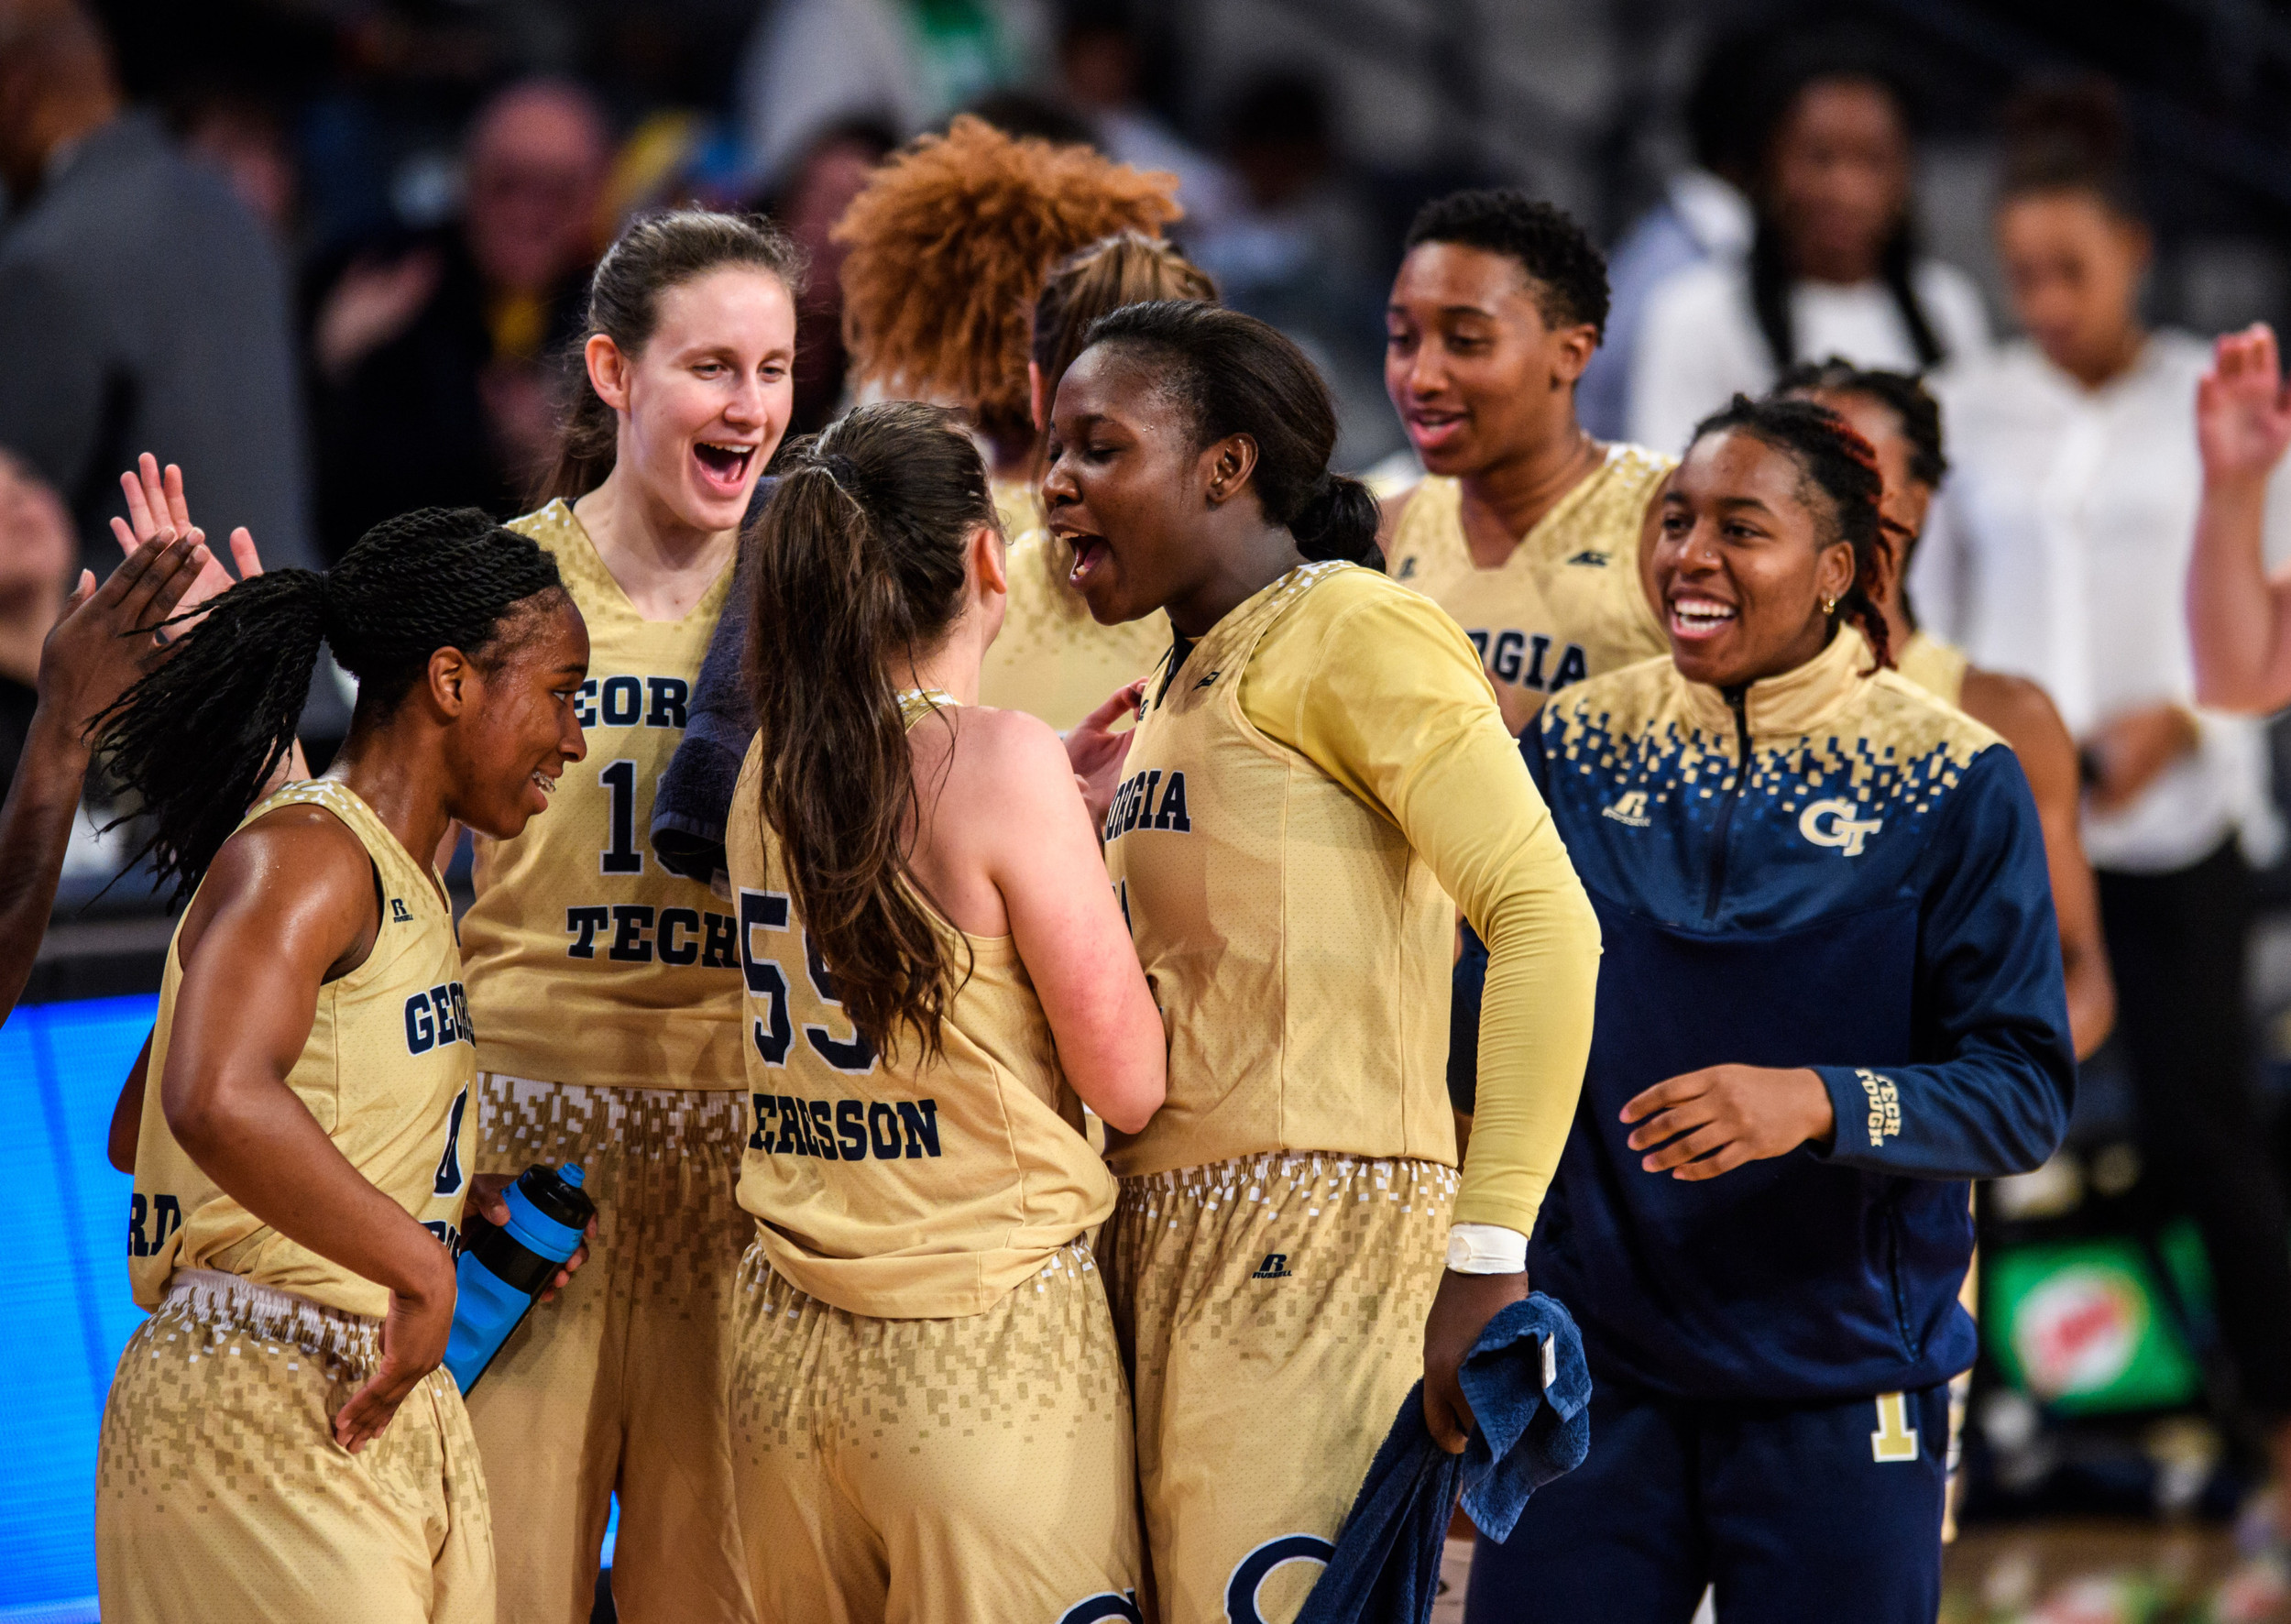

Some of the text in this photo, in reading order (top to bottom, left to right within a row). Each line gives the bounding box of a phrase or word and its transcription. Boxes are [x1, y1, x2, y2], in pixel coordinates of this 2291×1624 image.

[566, 904, 742, 968] TECH
[1855, 1068, 1883, 1147] TOUGH
[1875, 1074, 1902, 1136] TECH
[127, 1192, 181, 1257] RD
